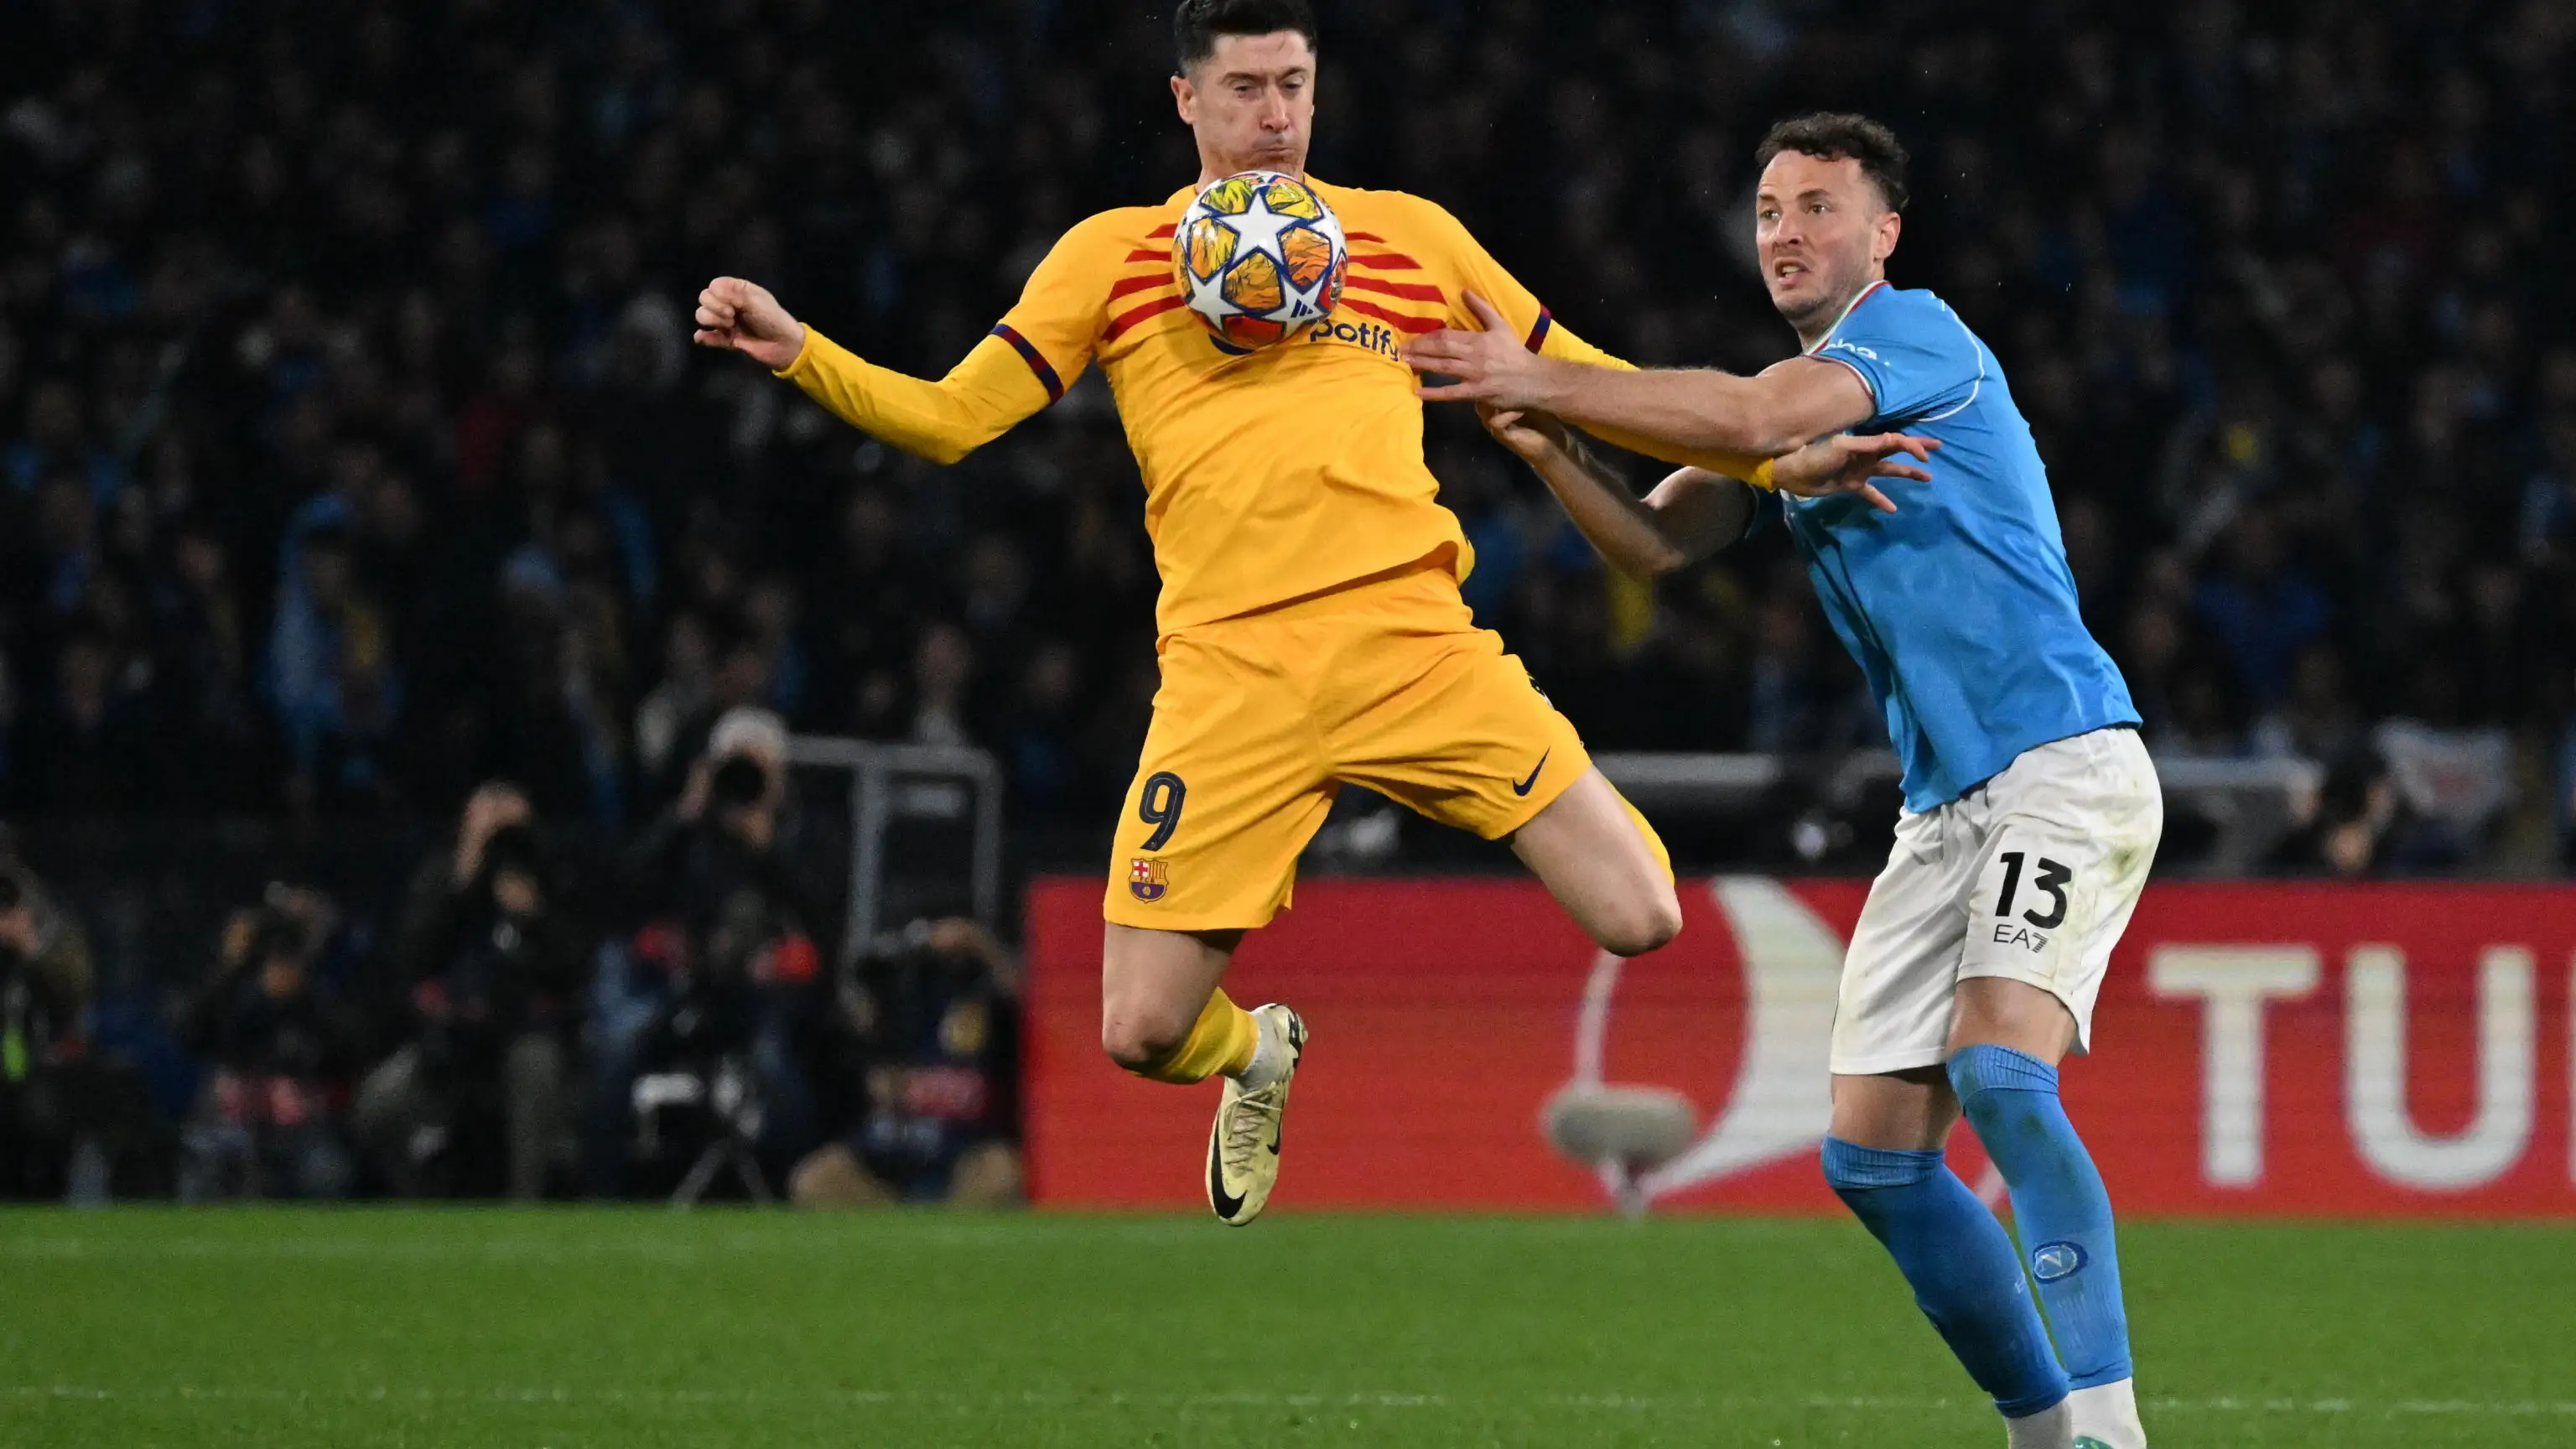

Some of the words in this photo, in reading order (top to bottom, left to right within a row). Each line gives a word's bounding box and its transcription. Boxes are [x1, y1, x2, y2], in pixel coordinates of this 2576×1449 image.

[1309, 319, 1399, 361] potify
[1139, 771, 1187, 852] 9
[1995, 852, 2072, 929] 13
[1993, 923, 2049, 953] EA7
[2148, 941, 2576, 1193] TU
